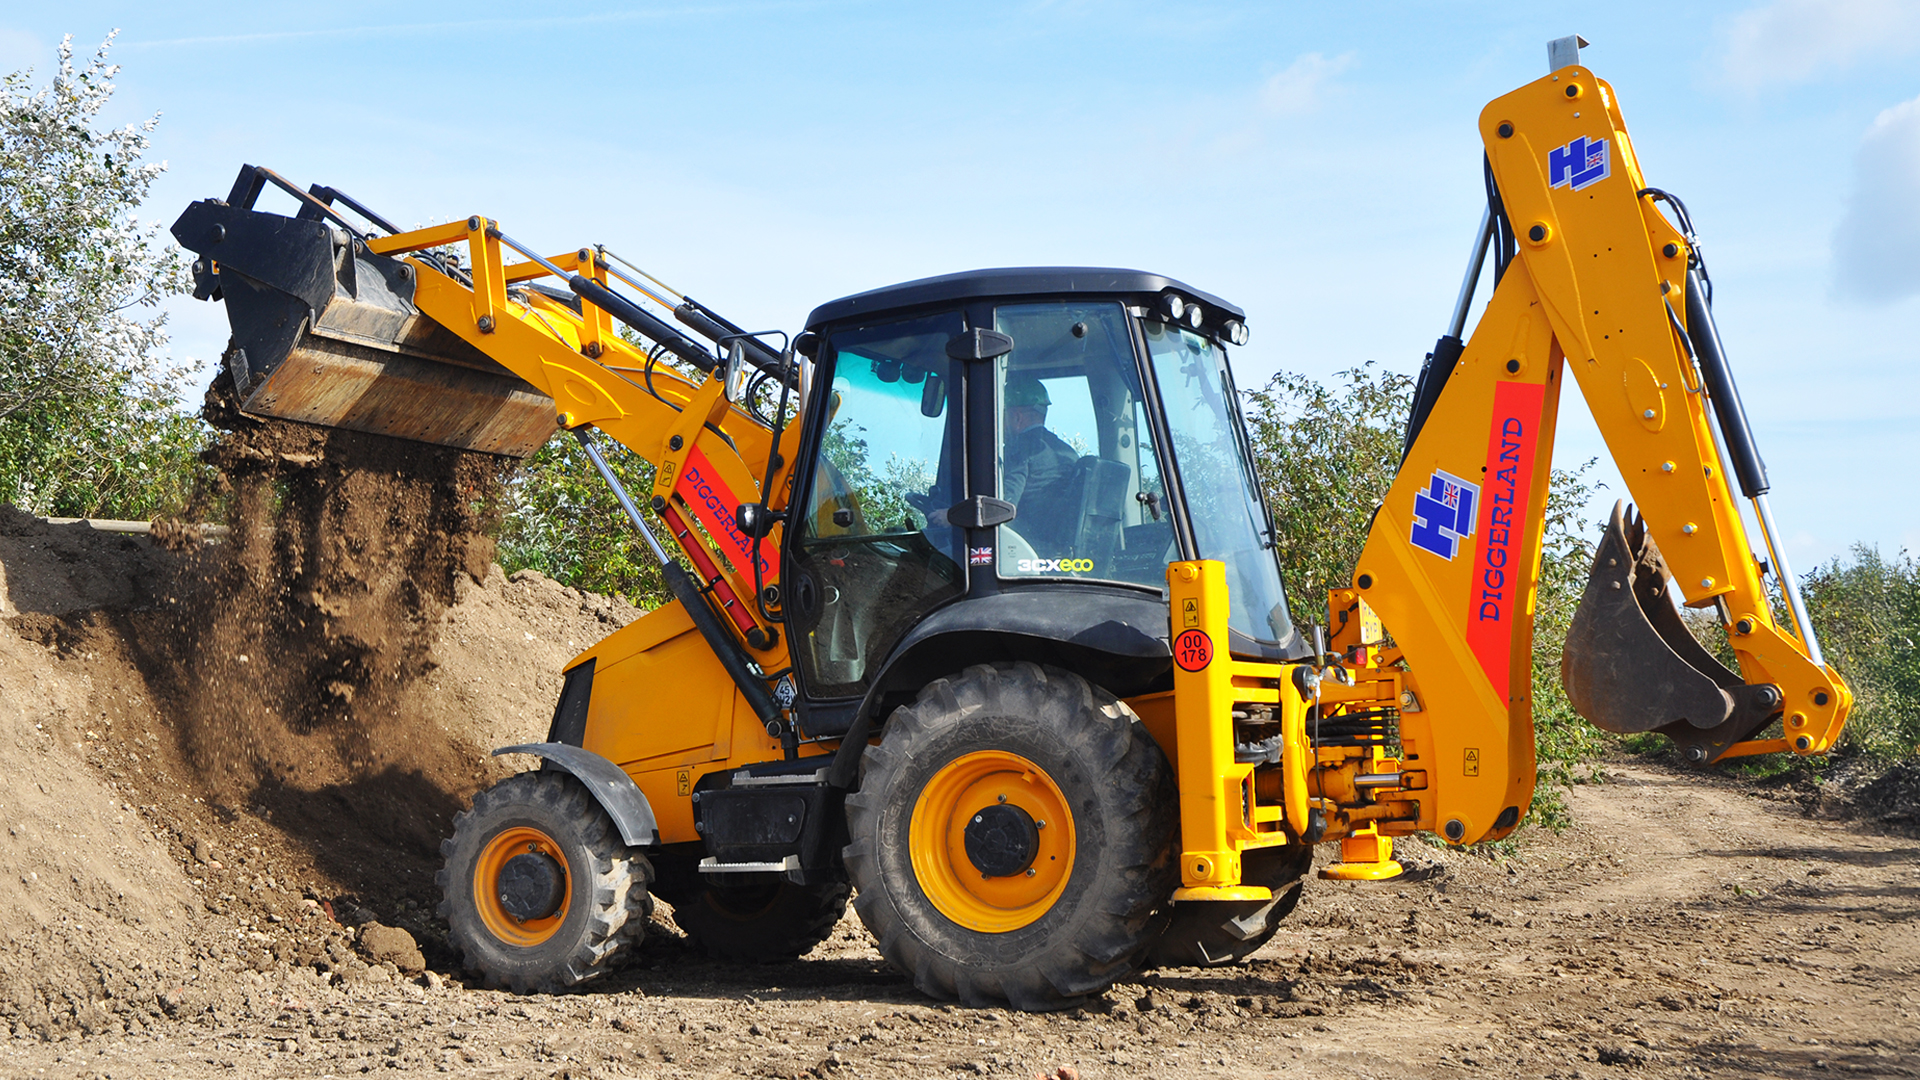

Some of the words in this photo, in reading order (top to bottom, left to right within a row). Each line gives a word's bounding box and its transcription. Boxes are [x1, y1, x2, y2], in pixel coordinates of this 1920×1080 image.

[685, 467, 769, 574] DIGGERLAND
[1480, 417, 1523, 621] DIGGERLAND
[1017, 558, 1094, 572] 3CXeco
[1184, 635, 1202, 649] 00
[1181, 648, 1207, 663] 178
[779, 685, 791, 695] 45
